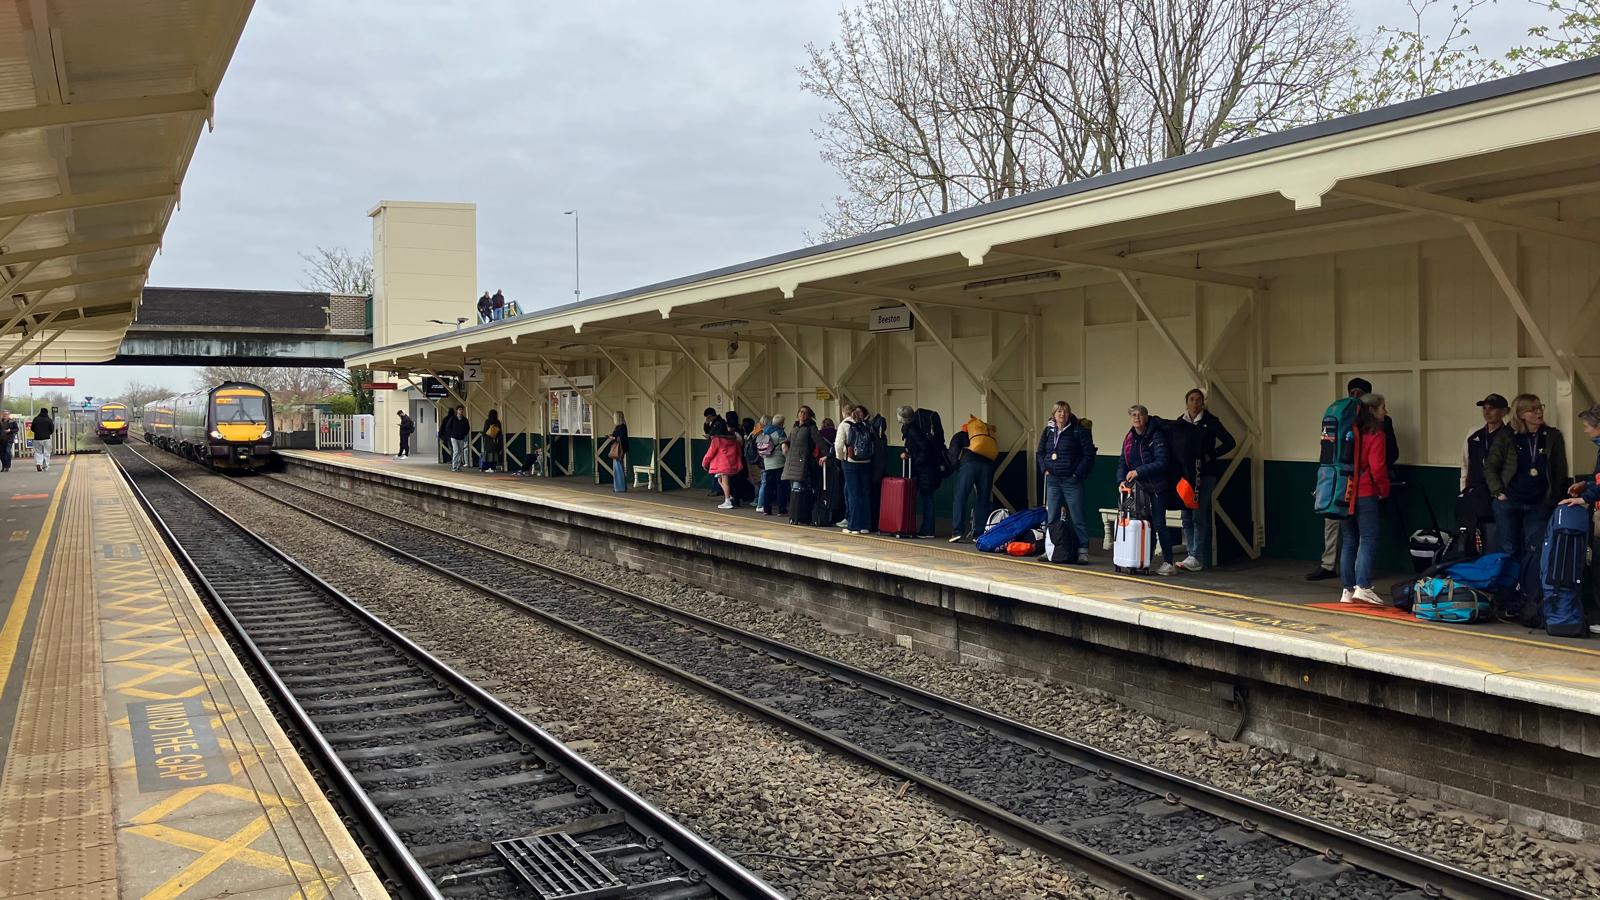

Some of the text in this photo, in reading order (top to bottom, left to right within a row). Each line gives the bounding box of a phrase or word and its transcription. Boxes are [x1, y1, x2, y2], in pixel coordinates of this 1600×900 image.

[879, 315, 900, 324] Beeston
[469, 368, 477, 378] 2
[145, 702, 208, 781] MIND THE GAP
